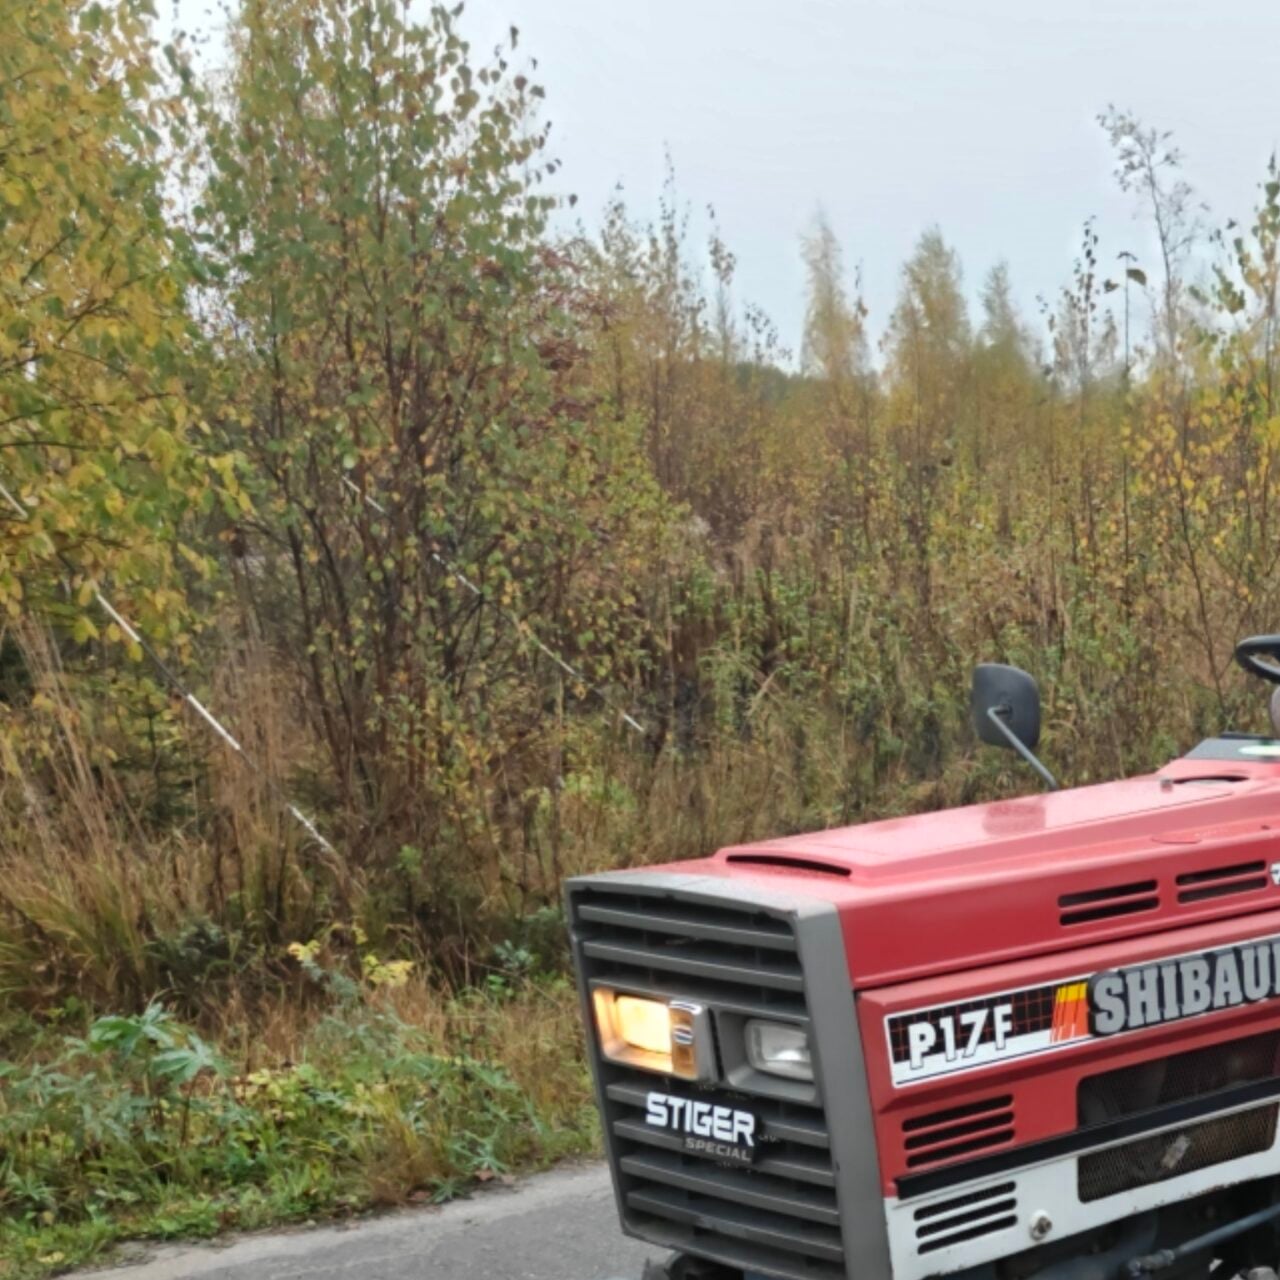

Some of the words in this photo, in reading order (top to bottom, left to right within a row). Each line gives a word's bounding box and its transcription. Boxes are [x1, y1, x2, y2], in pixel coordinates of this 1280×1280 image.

[907, 1003, 1013, 1071] P17F
[646, 1091, 755, 1147] STIGER
[685, 1137, 752, 1161] SPECIAL
